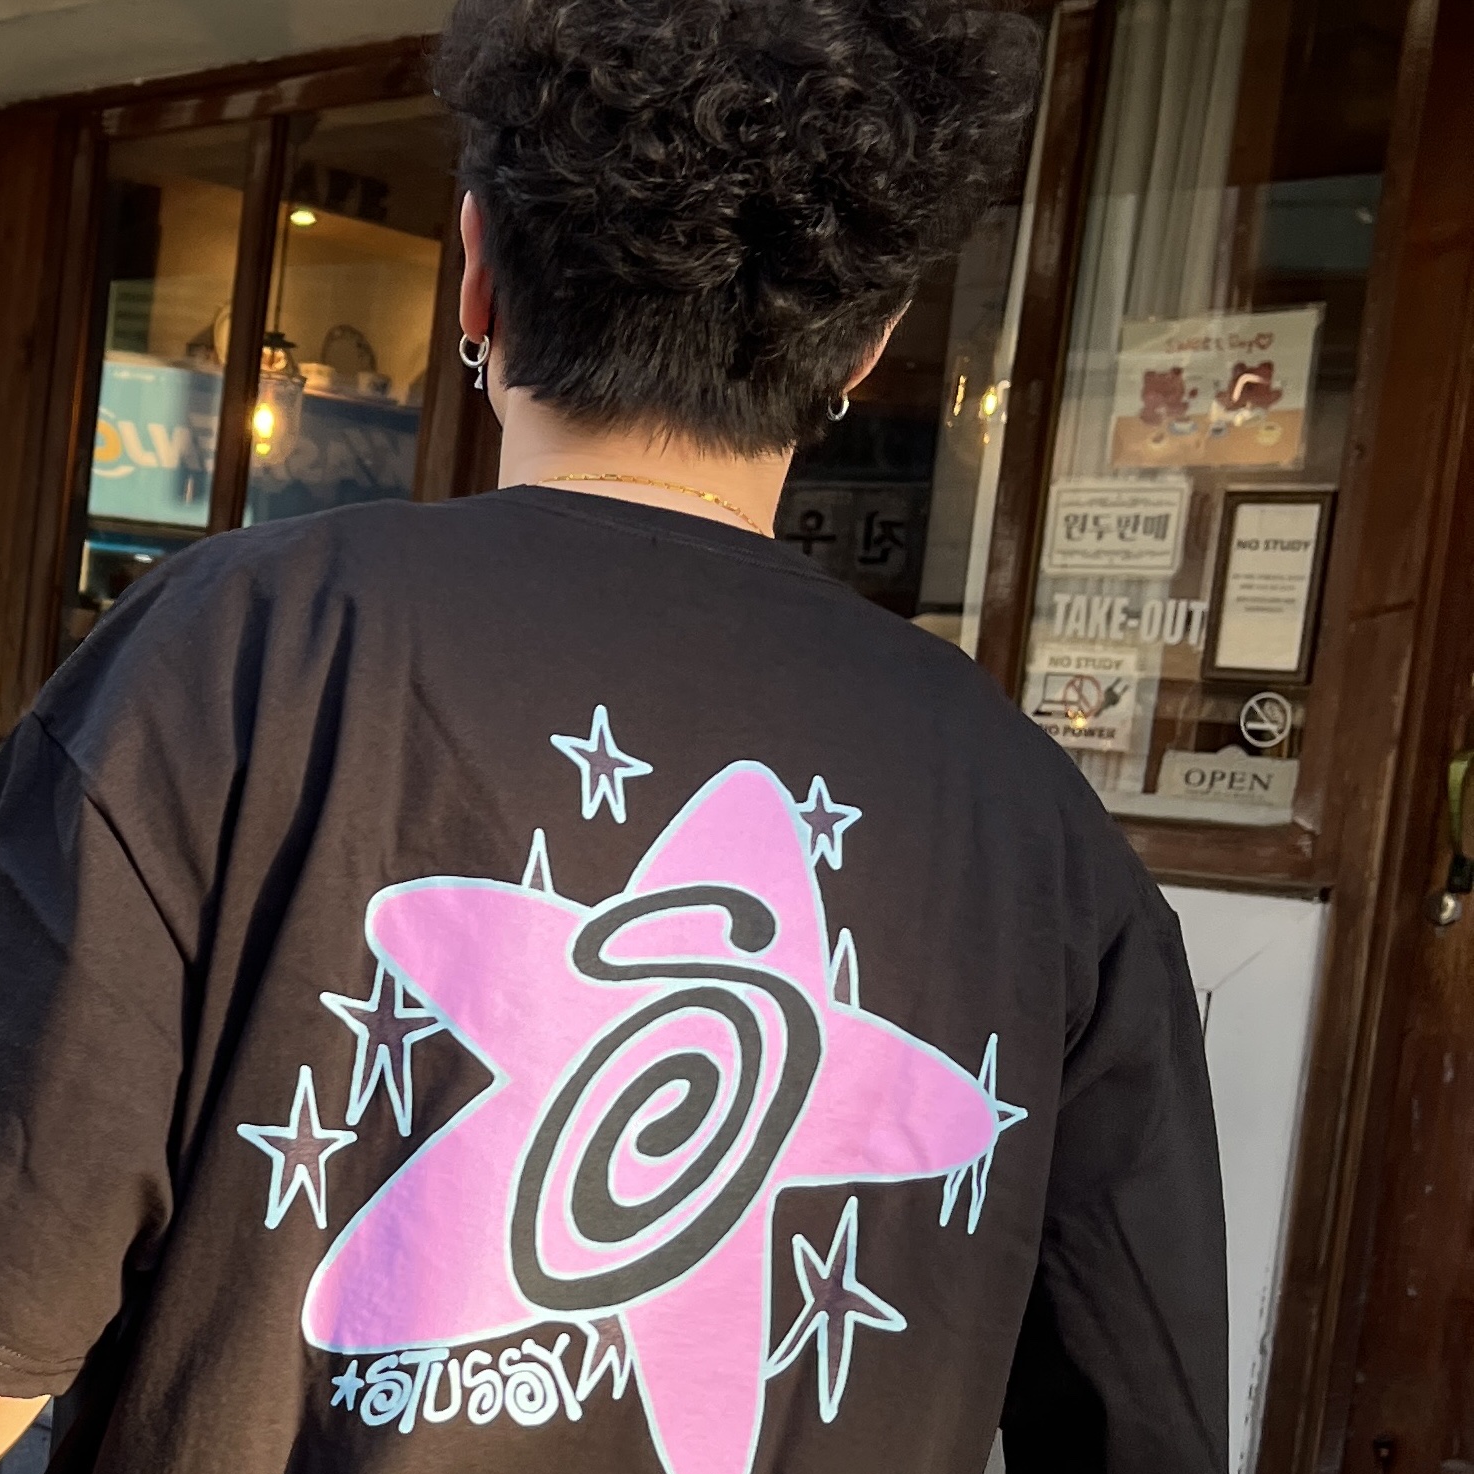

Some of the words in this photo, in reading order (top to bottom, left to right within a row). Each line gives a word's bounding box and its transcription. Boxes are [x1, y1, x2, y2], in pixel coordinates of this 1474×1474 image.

[1063, 511, 1171, 542] 원두판매
[1236, 538, 1260, 551] NO
[1263, 538, 1312, 552] STUDY
[1052, 593, 1210, 647] TAKE-OUT
[1048, 655, 1072, 669] NO
[1075, 656, 1124, 671] STUDY
[1062, 725, 1116, 739] POWER
[1184, 767, 1275, 793] OPEN
